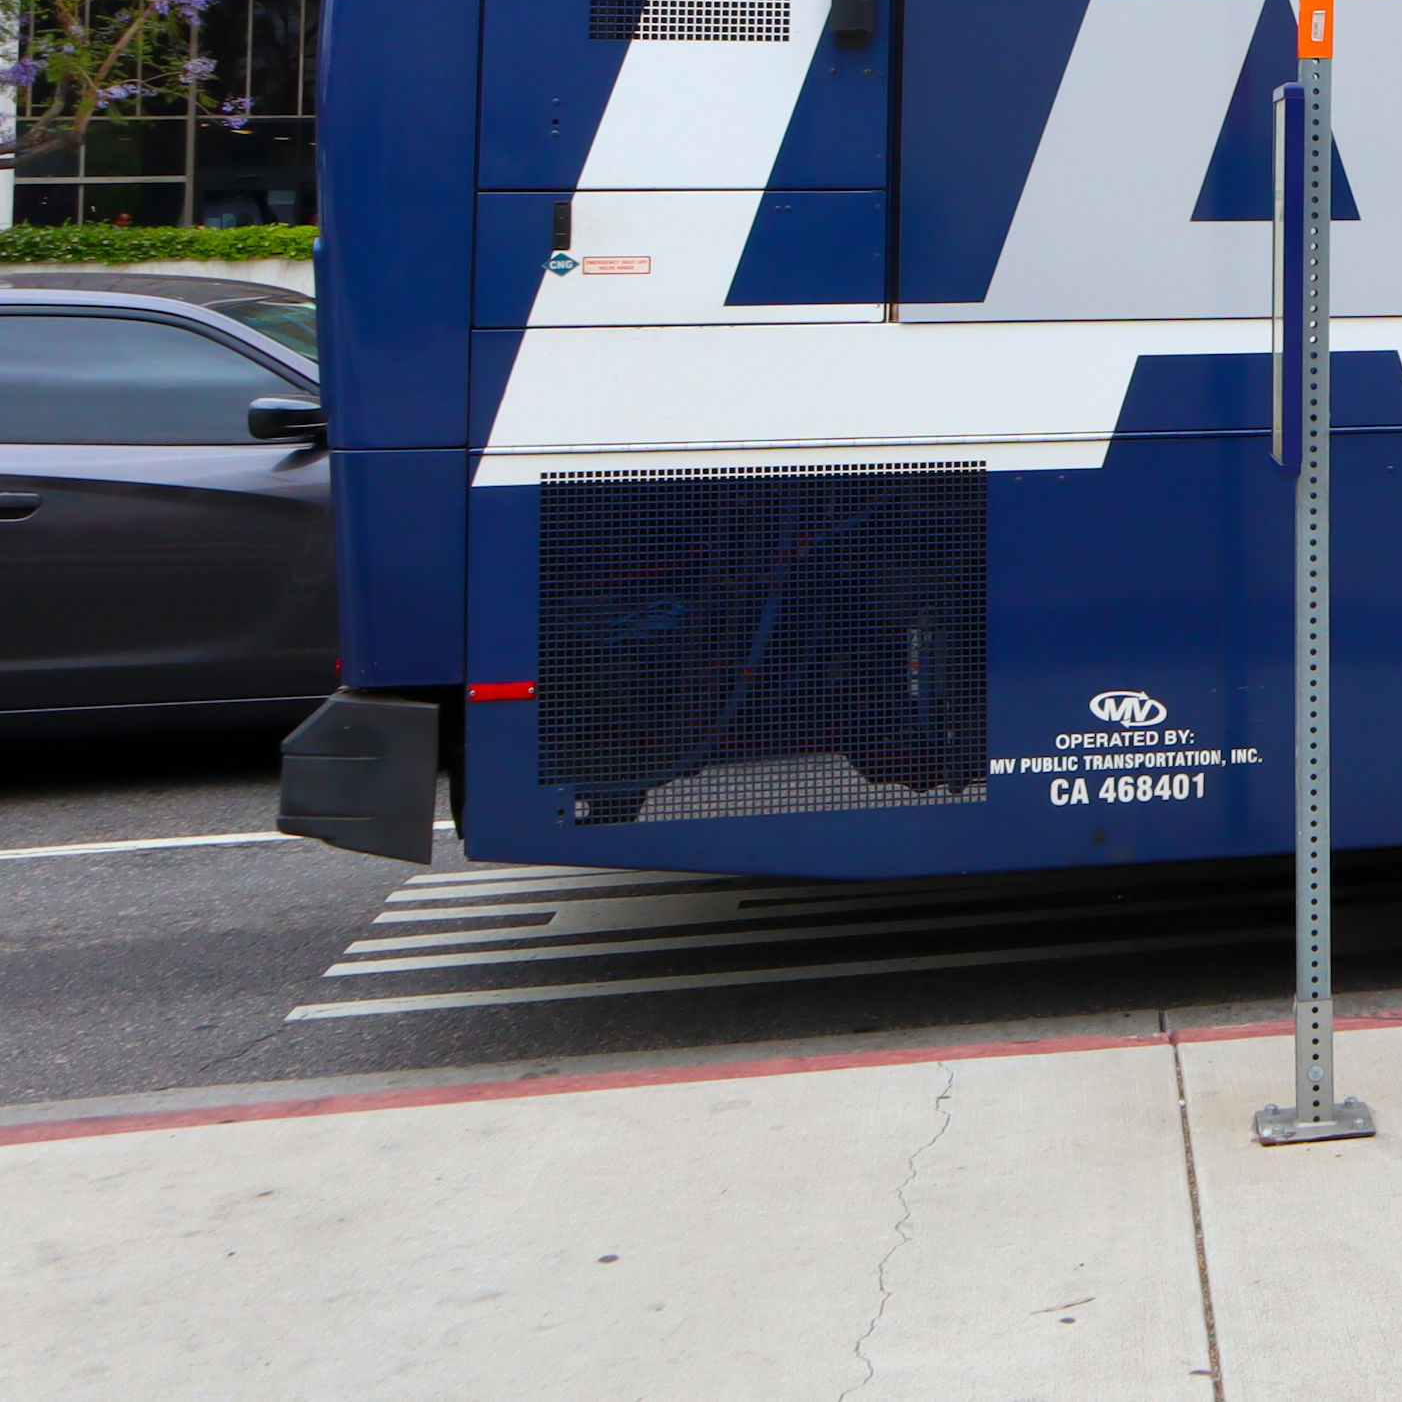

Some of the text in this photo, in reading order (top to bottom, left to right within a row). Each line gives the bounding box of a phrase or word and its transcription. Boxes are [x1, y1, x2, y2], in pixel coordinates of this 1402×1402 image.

[549, 260, 574, 270] CNG
[1055, 728, 1195, 750] OPERATED BY:
[989, 747, 1264, 775] MV PUBLIC TRANSPORTATION, INC.
[1050, 771, 1205, 807] CA 468401
